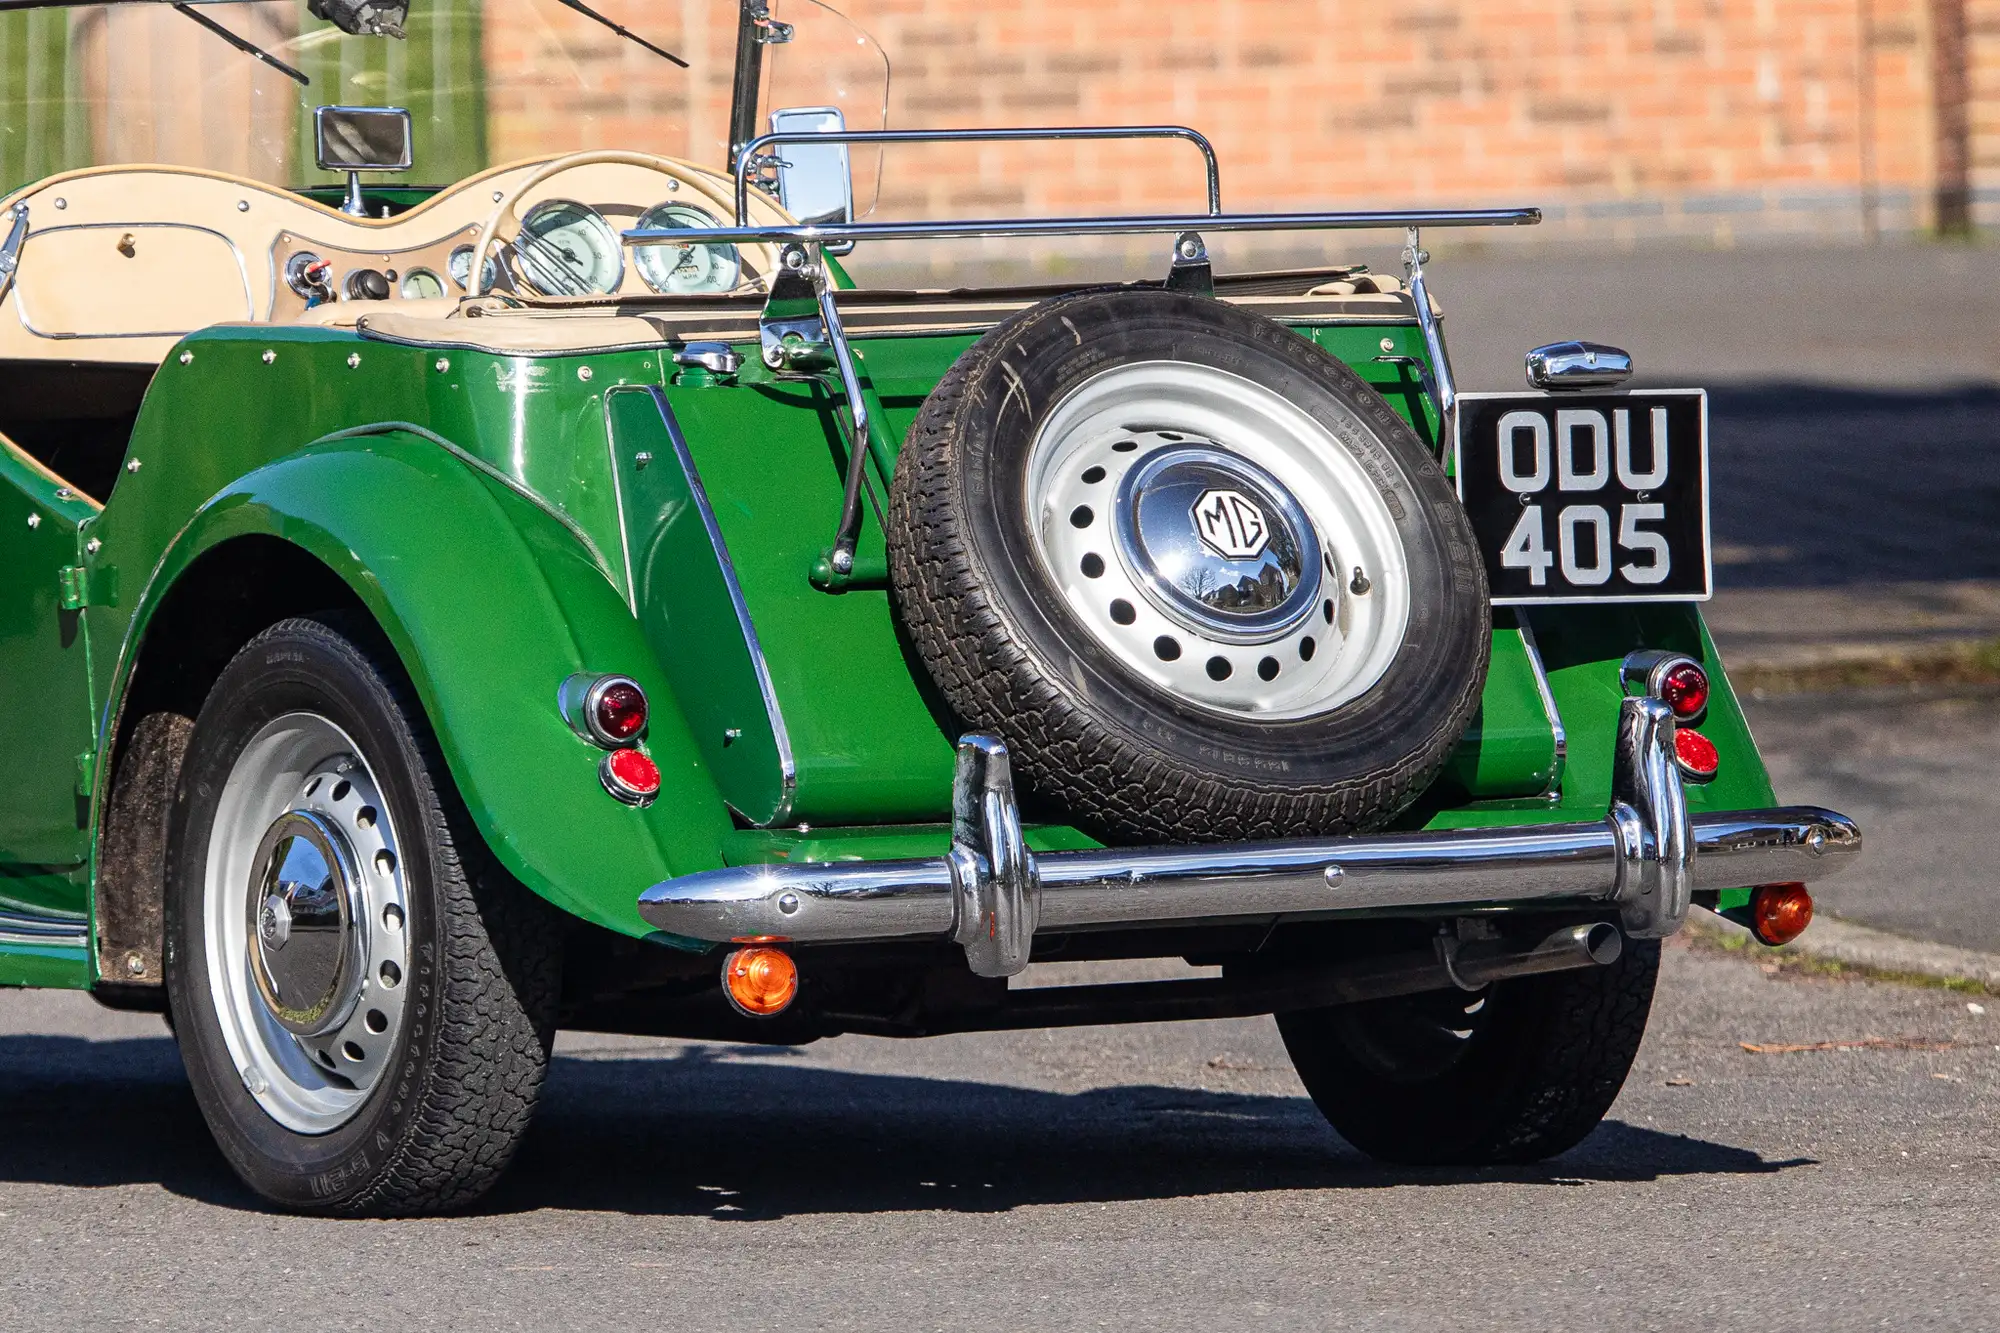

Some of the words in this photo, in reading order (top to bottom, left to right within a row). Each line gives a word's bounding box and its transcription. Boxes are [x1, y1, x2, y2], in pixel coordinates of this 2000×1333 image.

[1497, 407, 1668, 493] ODU
[1203, 495, 1263, 549] MG
[1501, 503, 1670, 586] 405
